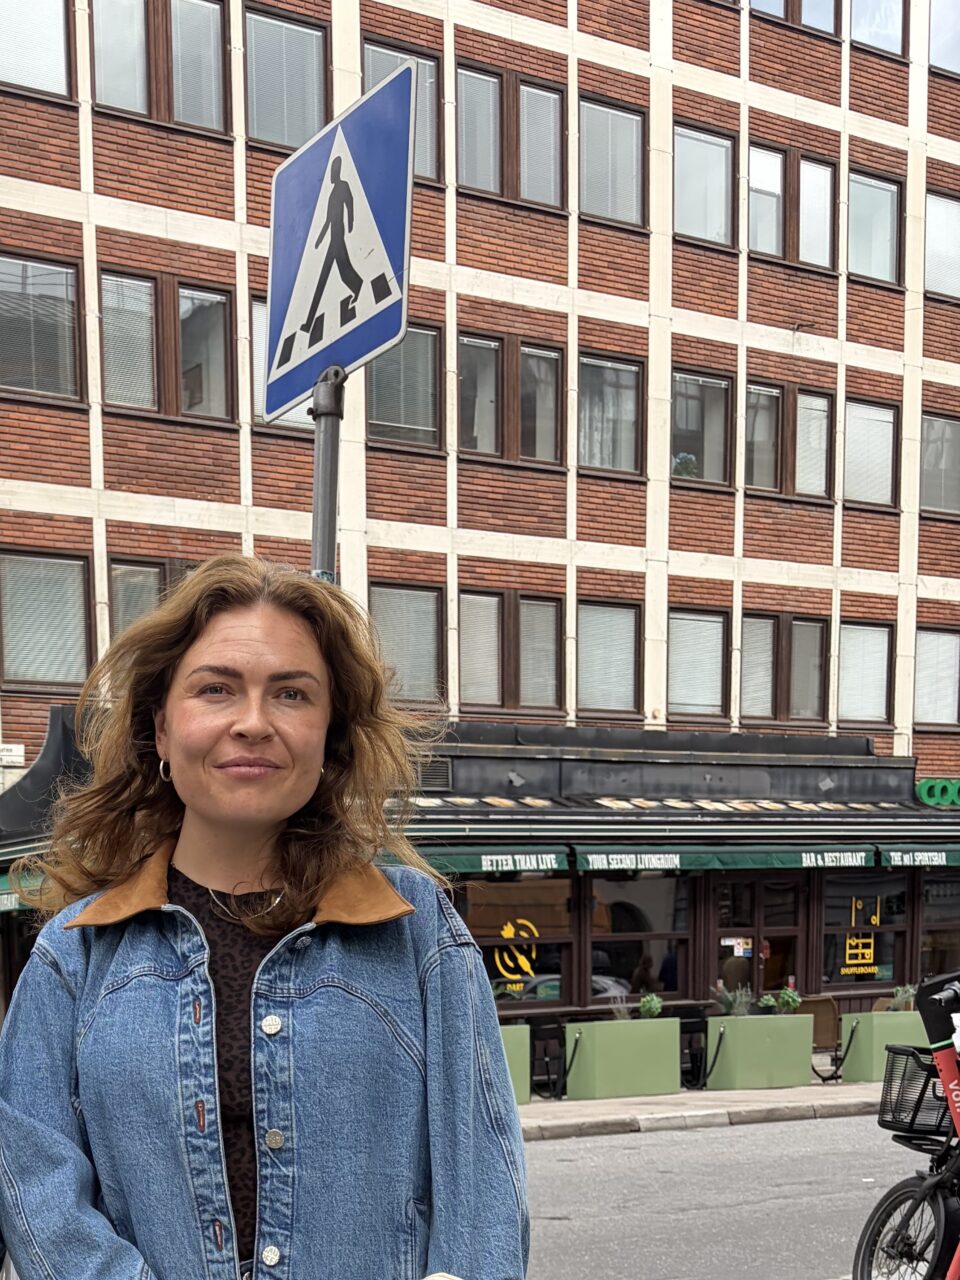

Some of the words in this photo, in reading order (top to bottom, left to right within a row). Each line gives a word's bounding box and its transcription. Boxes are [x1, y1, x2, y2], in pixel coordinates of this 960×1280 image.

[481, 854, 515, 871] BETTER
[514, 854, 538, 870] THAN
[538, 854, 558, 869] LIVE
[587, 854, 609, 870] YOUR
[608, 854, 636, 869] SECOND
[637, 854, 680, 869] LIVINGROOM
[802, 853, 817, 867] BAR
[817, 854, 824, 866] &
[824, 852, 866, 867] RESTAURANT
[890, 852, 903, 865] THE
[914, 852, 947, 865] SPORTSBAR
